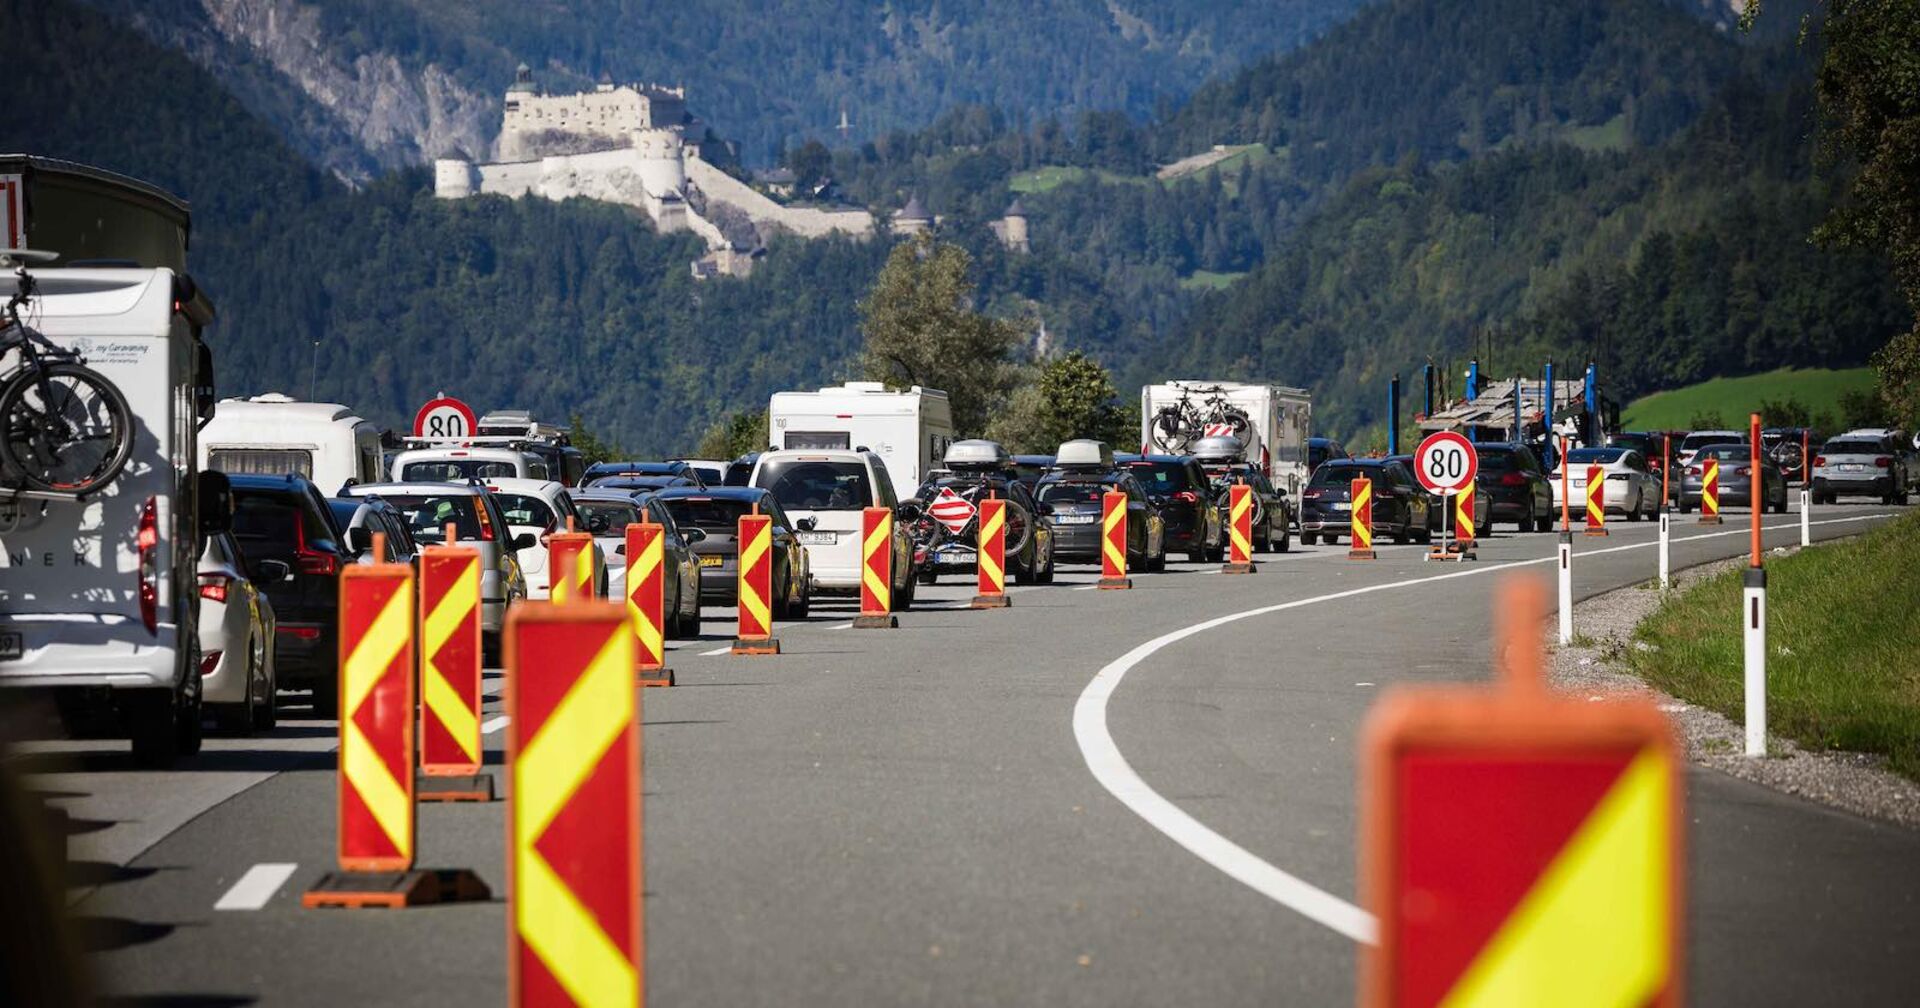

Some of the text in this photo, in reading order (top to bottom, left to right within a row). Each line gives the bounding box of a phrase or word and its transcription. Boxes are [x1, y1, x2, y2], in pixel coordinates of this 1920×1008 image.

[96, 342, 149, 354] my Caravaning
[430, 415, 462, 445] 80
[1430, 449, 1462, 478] 80
